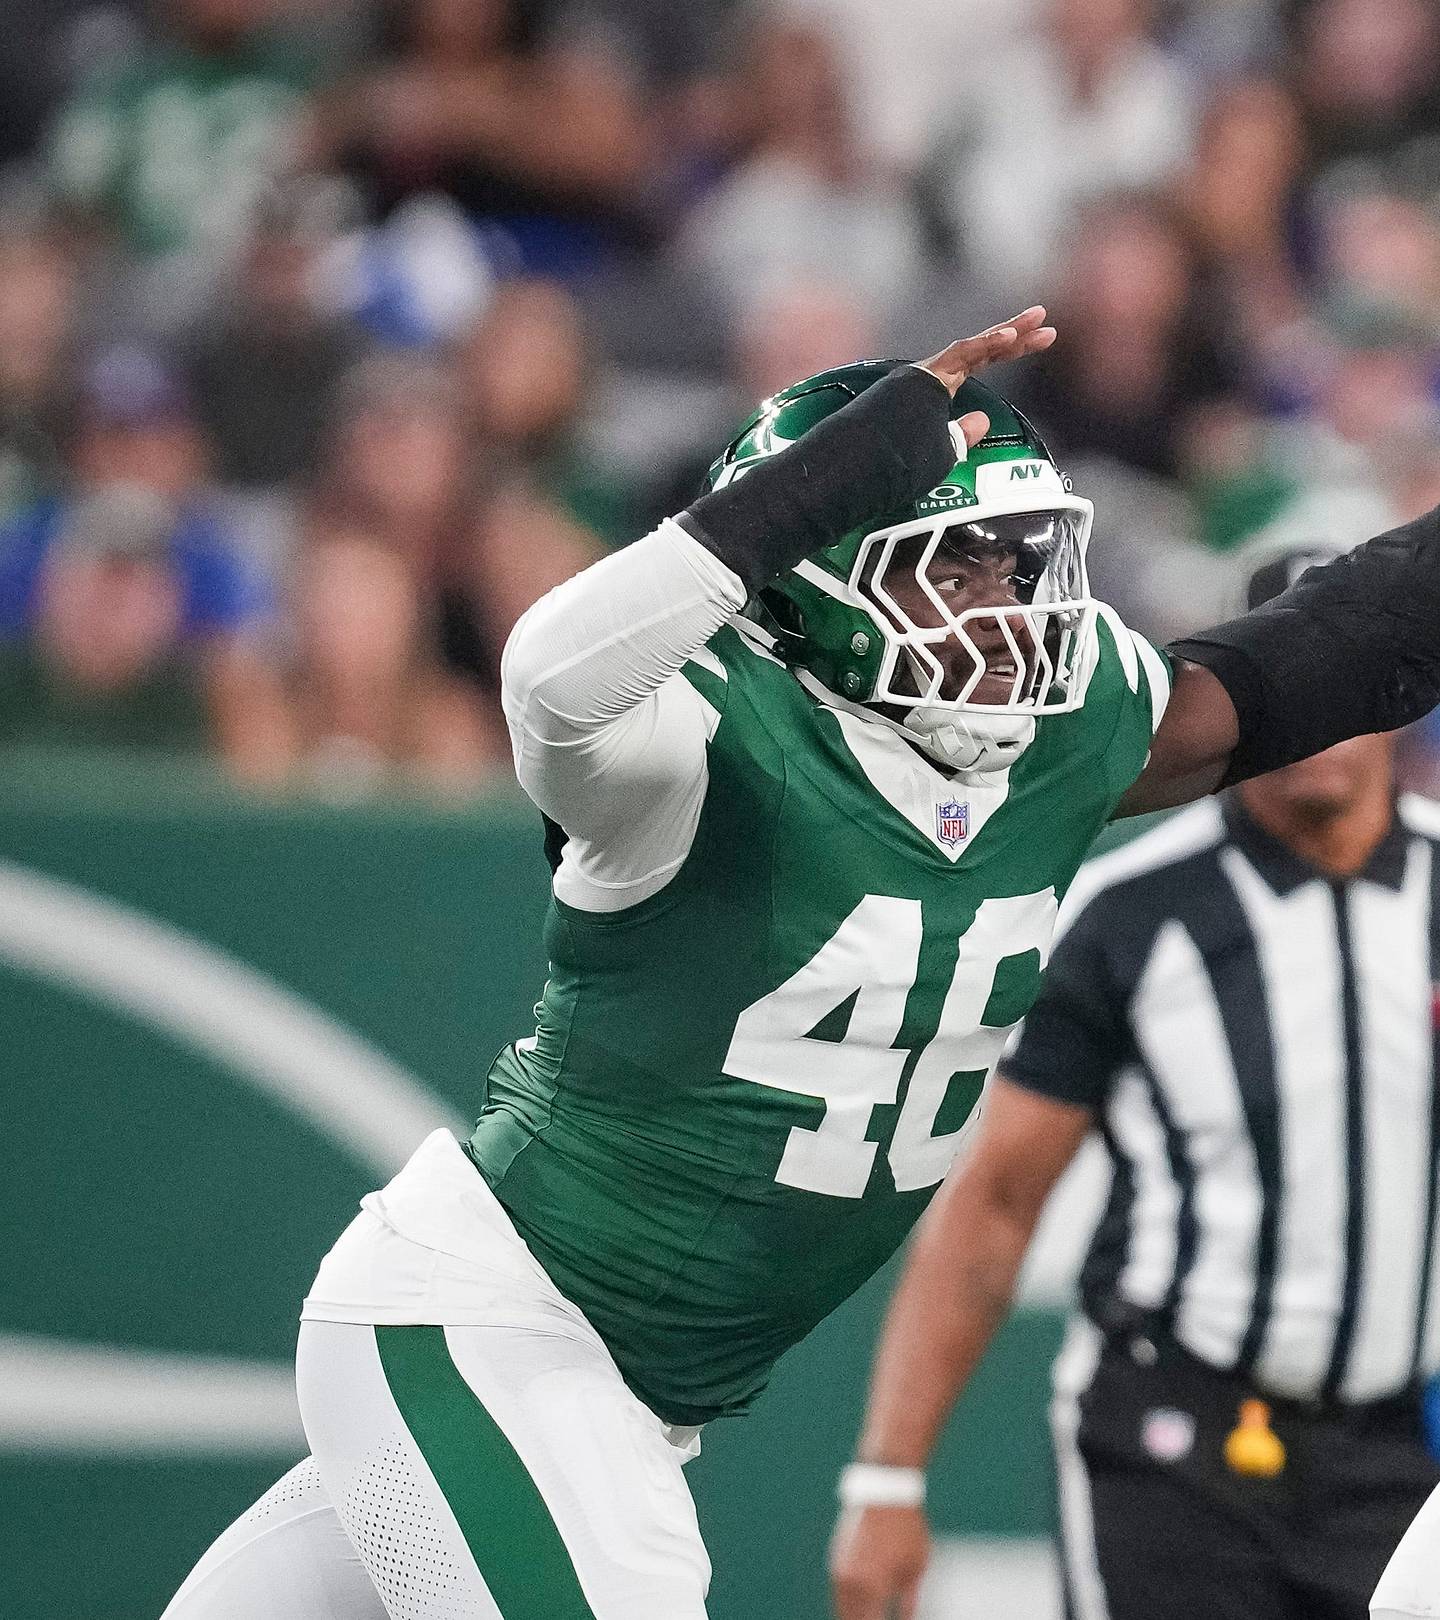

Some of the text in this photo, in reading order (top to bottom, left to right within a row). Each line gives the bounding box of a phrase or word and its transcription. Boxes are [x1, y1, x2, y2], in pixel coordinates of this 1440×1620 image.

[1010, 464, 1042, 480] NY
[920, 498, 974, 509] OAKLEY
[943, 819, 965, 839] NFL
